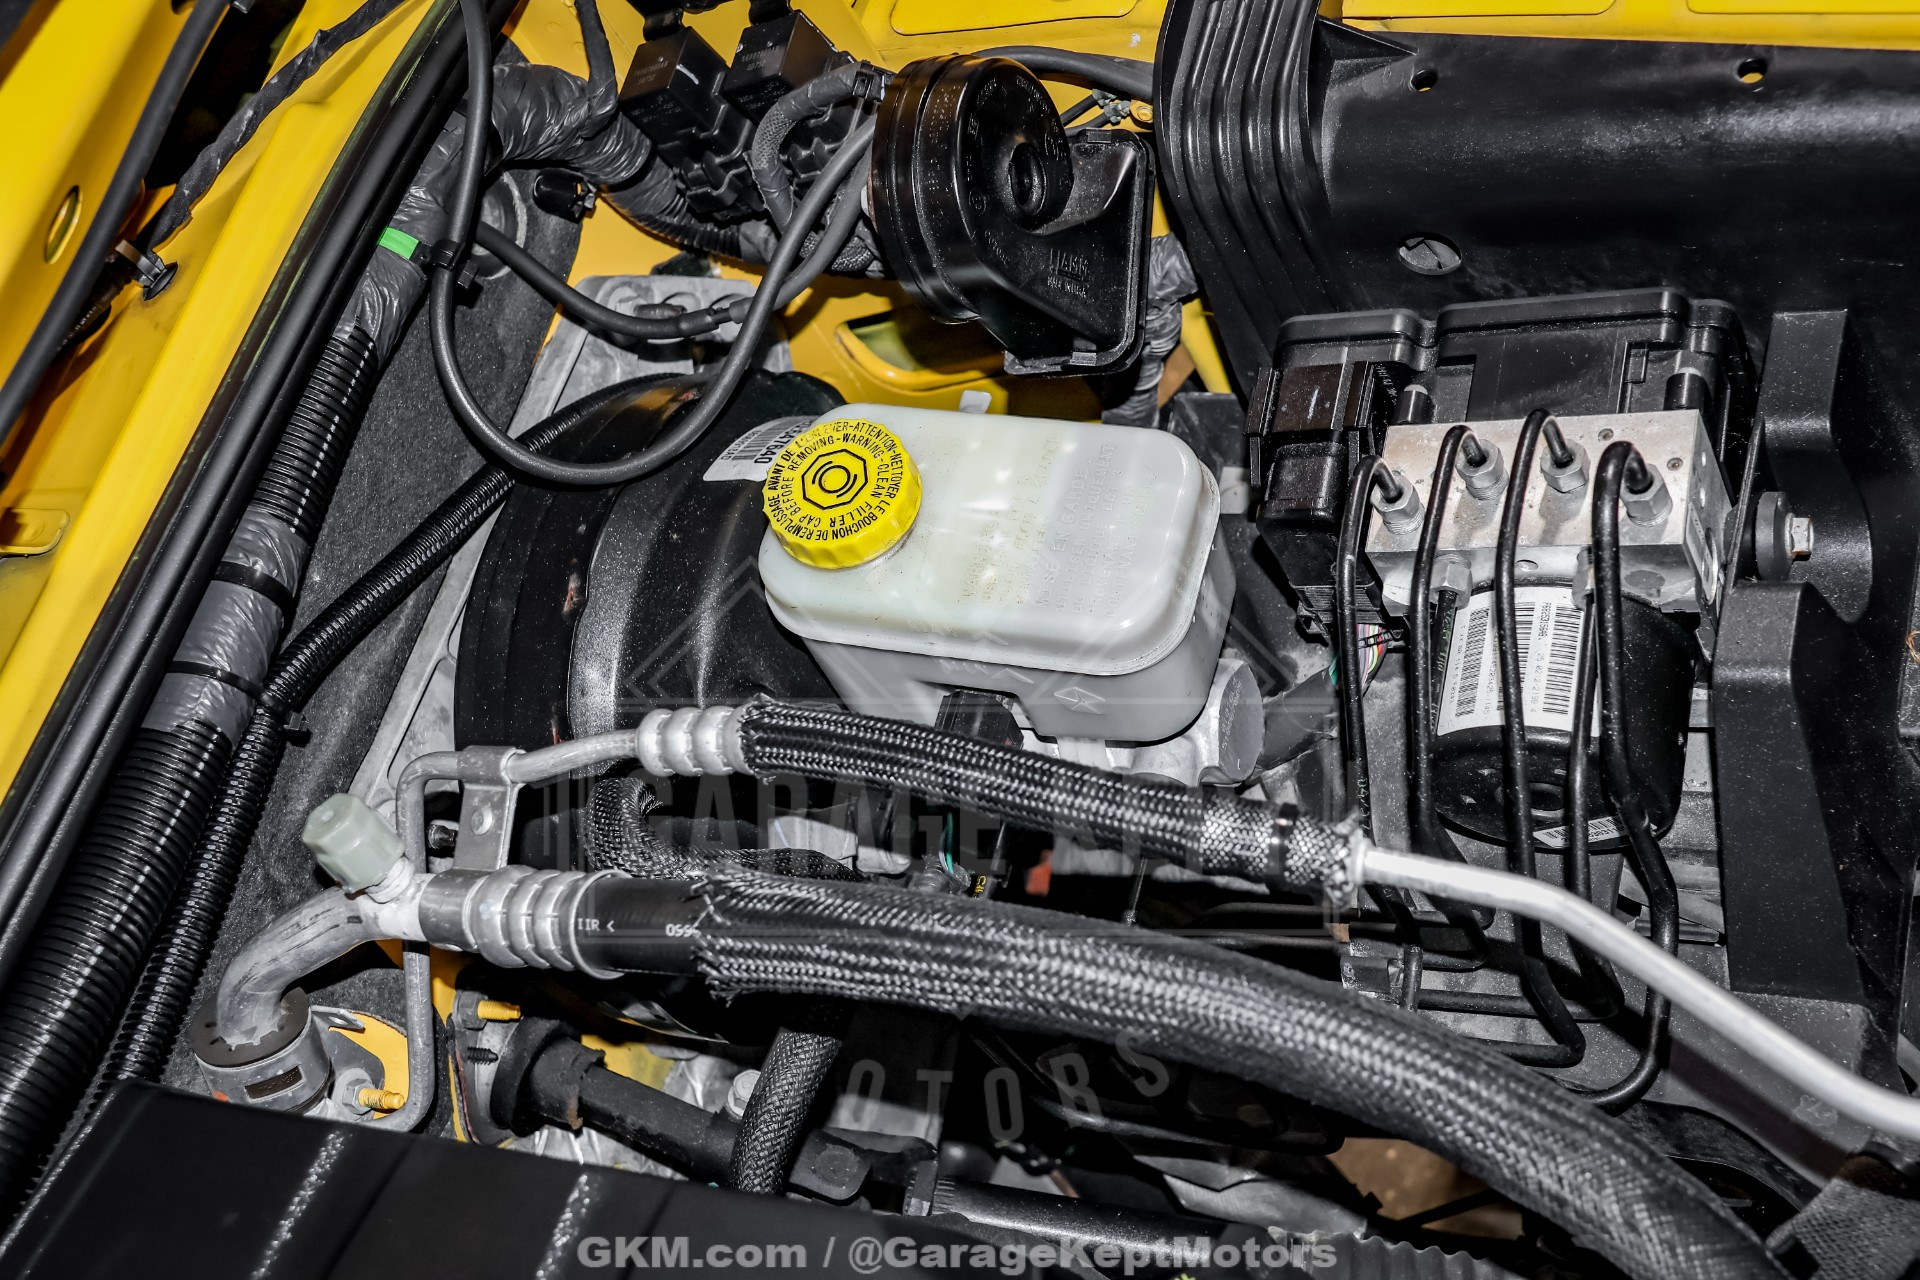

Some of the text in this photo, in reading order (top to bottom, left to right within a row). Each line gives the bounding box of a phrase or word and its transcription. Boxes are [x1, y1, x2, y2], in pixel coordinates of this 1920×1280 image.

[780, 447, 796, 461] DE
[767, 462, 786, 491] AVANT
[780, 476, 801, 516] BEFORE
[874, 499, 891, 515] LE
[767, 493, 815, 541] REMPLISSAGE
[798, 513, 821, 528] CAP
[829, 501, 873, 528] FILLER
[831, 511, 878, 540] BOUCHON
[815, 529, 828, 541] DE
